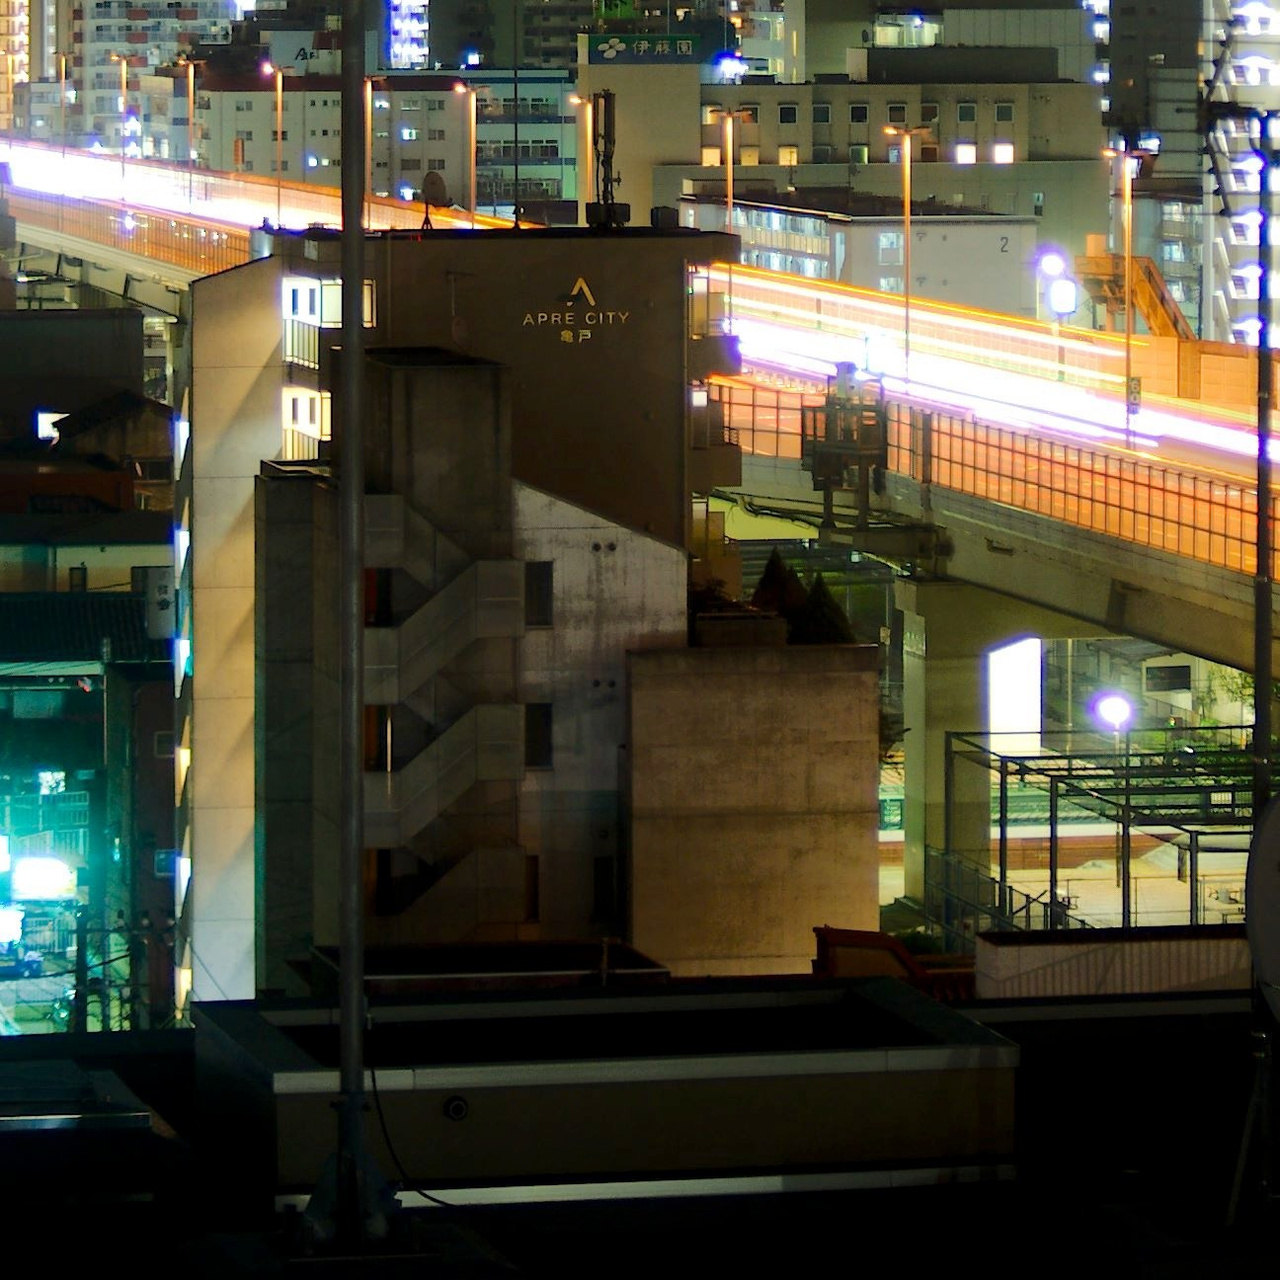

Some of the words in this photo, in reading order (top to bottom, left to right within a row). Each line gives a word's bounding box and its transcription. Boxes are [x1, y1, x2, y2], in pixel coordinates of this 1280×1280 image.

[632, 39, 693, 56] 伊藤園
[1000, 236, 1010, 254] 2
[522, 311, 576, 327] APRE
[585, 311, 630, 326] CITY
